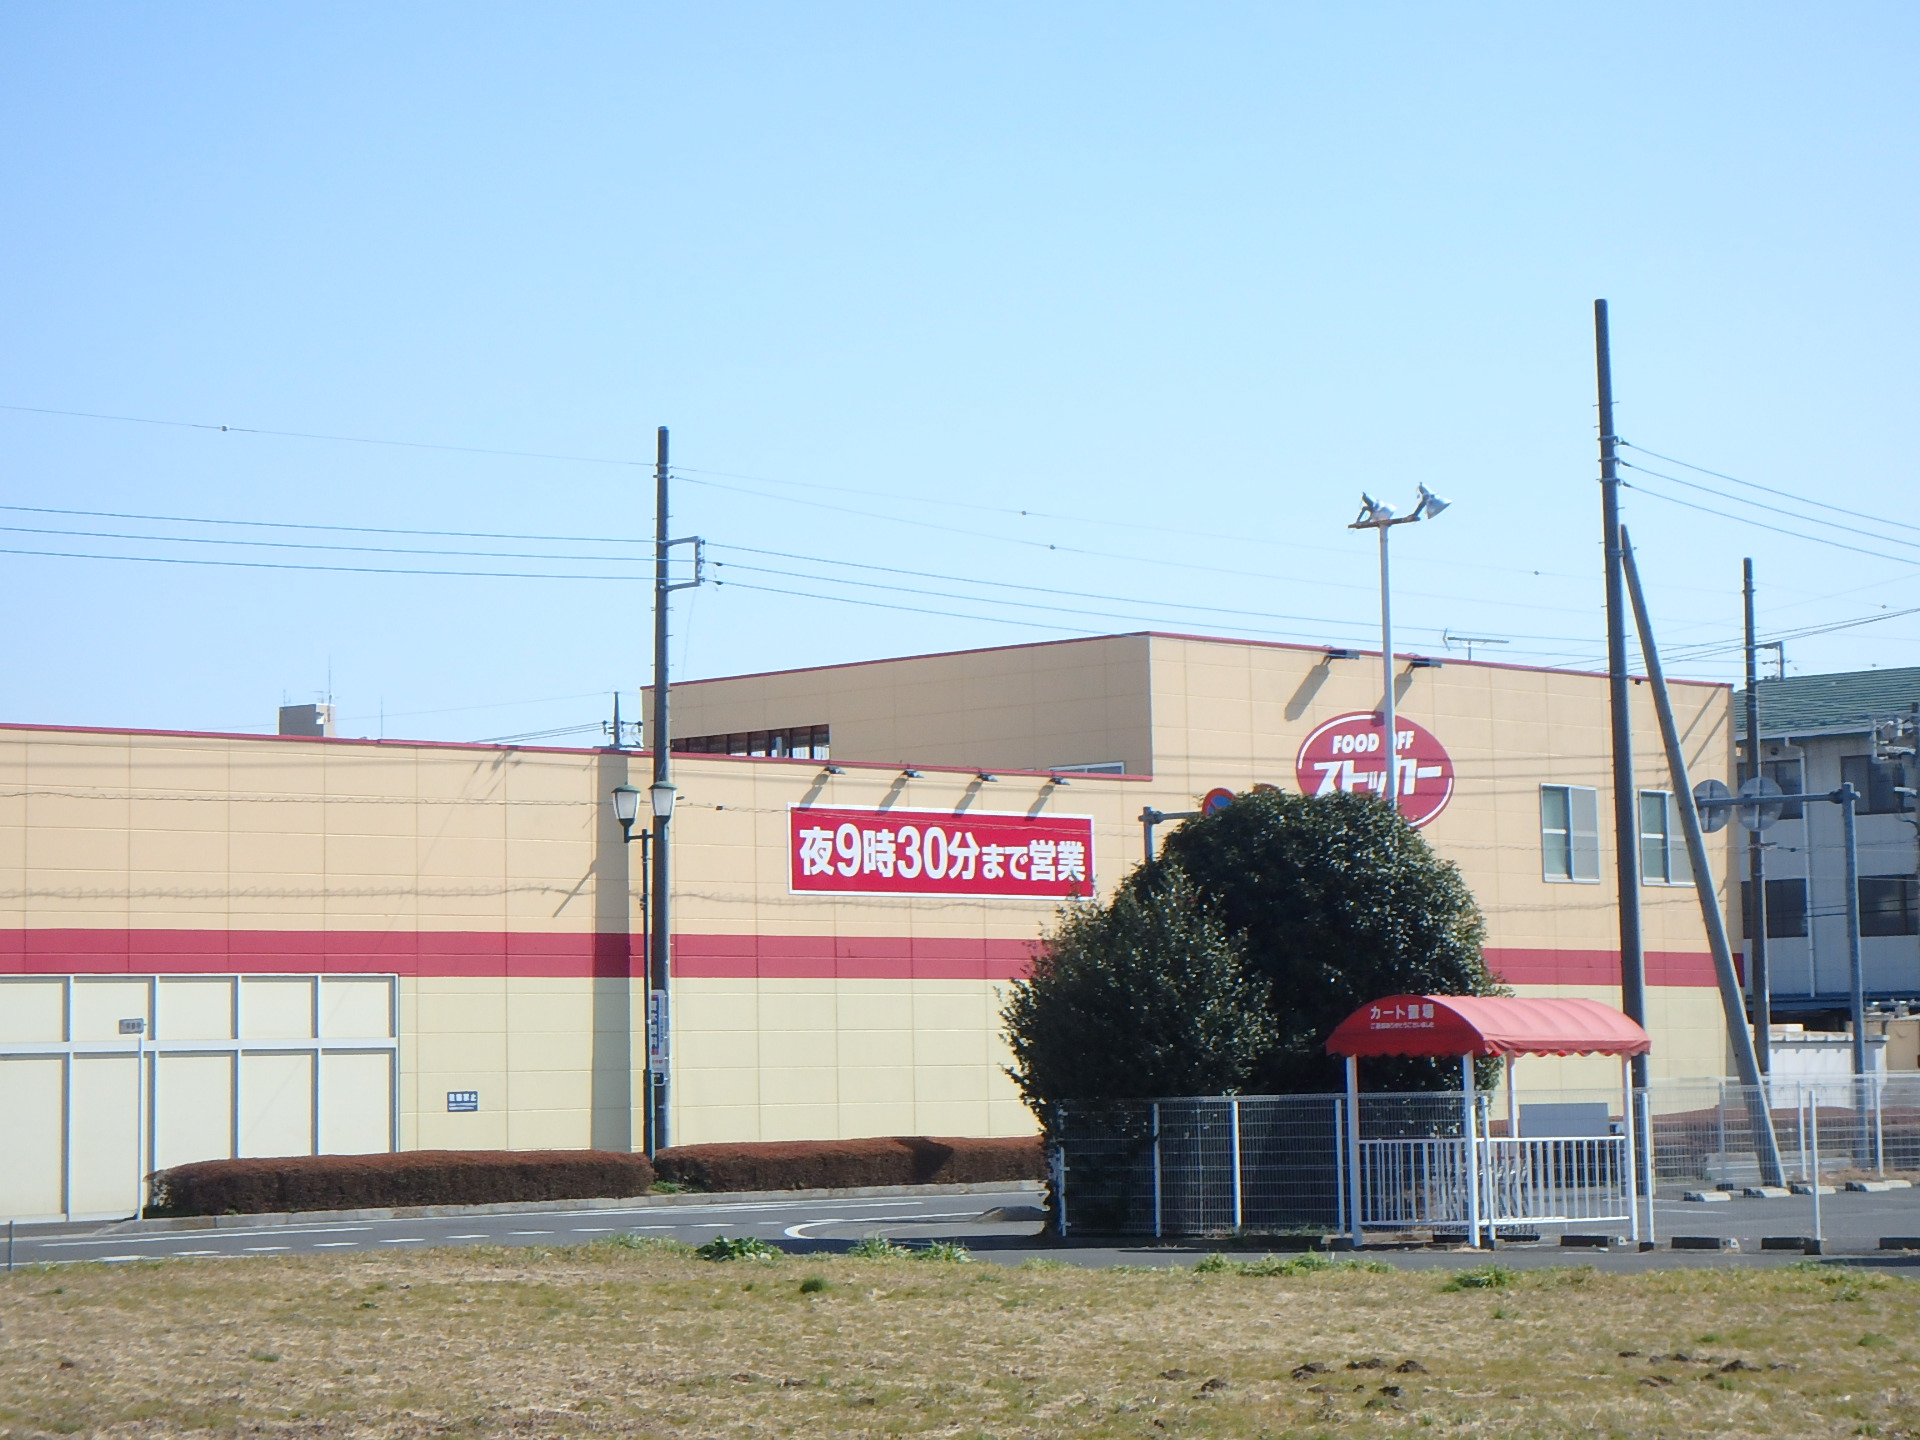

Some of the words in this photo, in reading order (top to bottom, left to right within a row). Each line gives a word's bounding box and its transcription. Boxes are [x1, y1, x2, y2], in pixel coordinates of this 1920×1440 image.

[1332, 733, 1380, 754] FOOD
[1393, 731, 1415, 750] FF
[799, 823, 1086, 881] 夜9時30分まで営業
